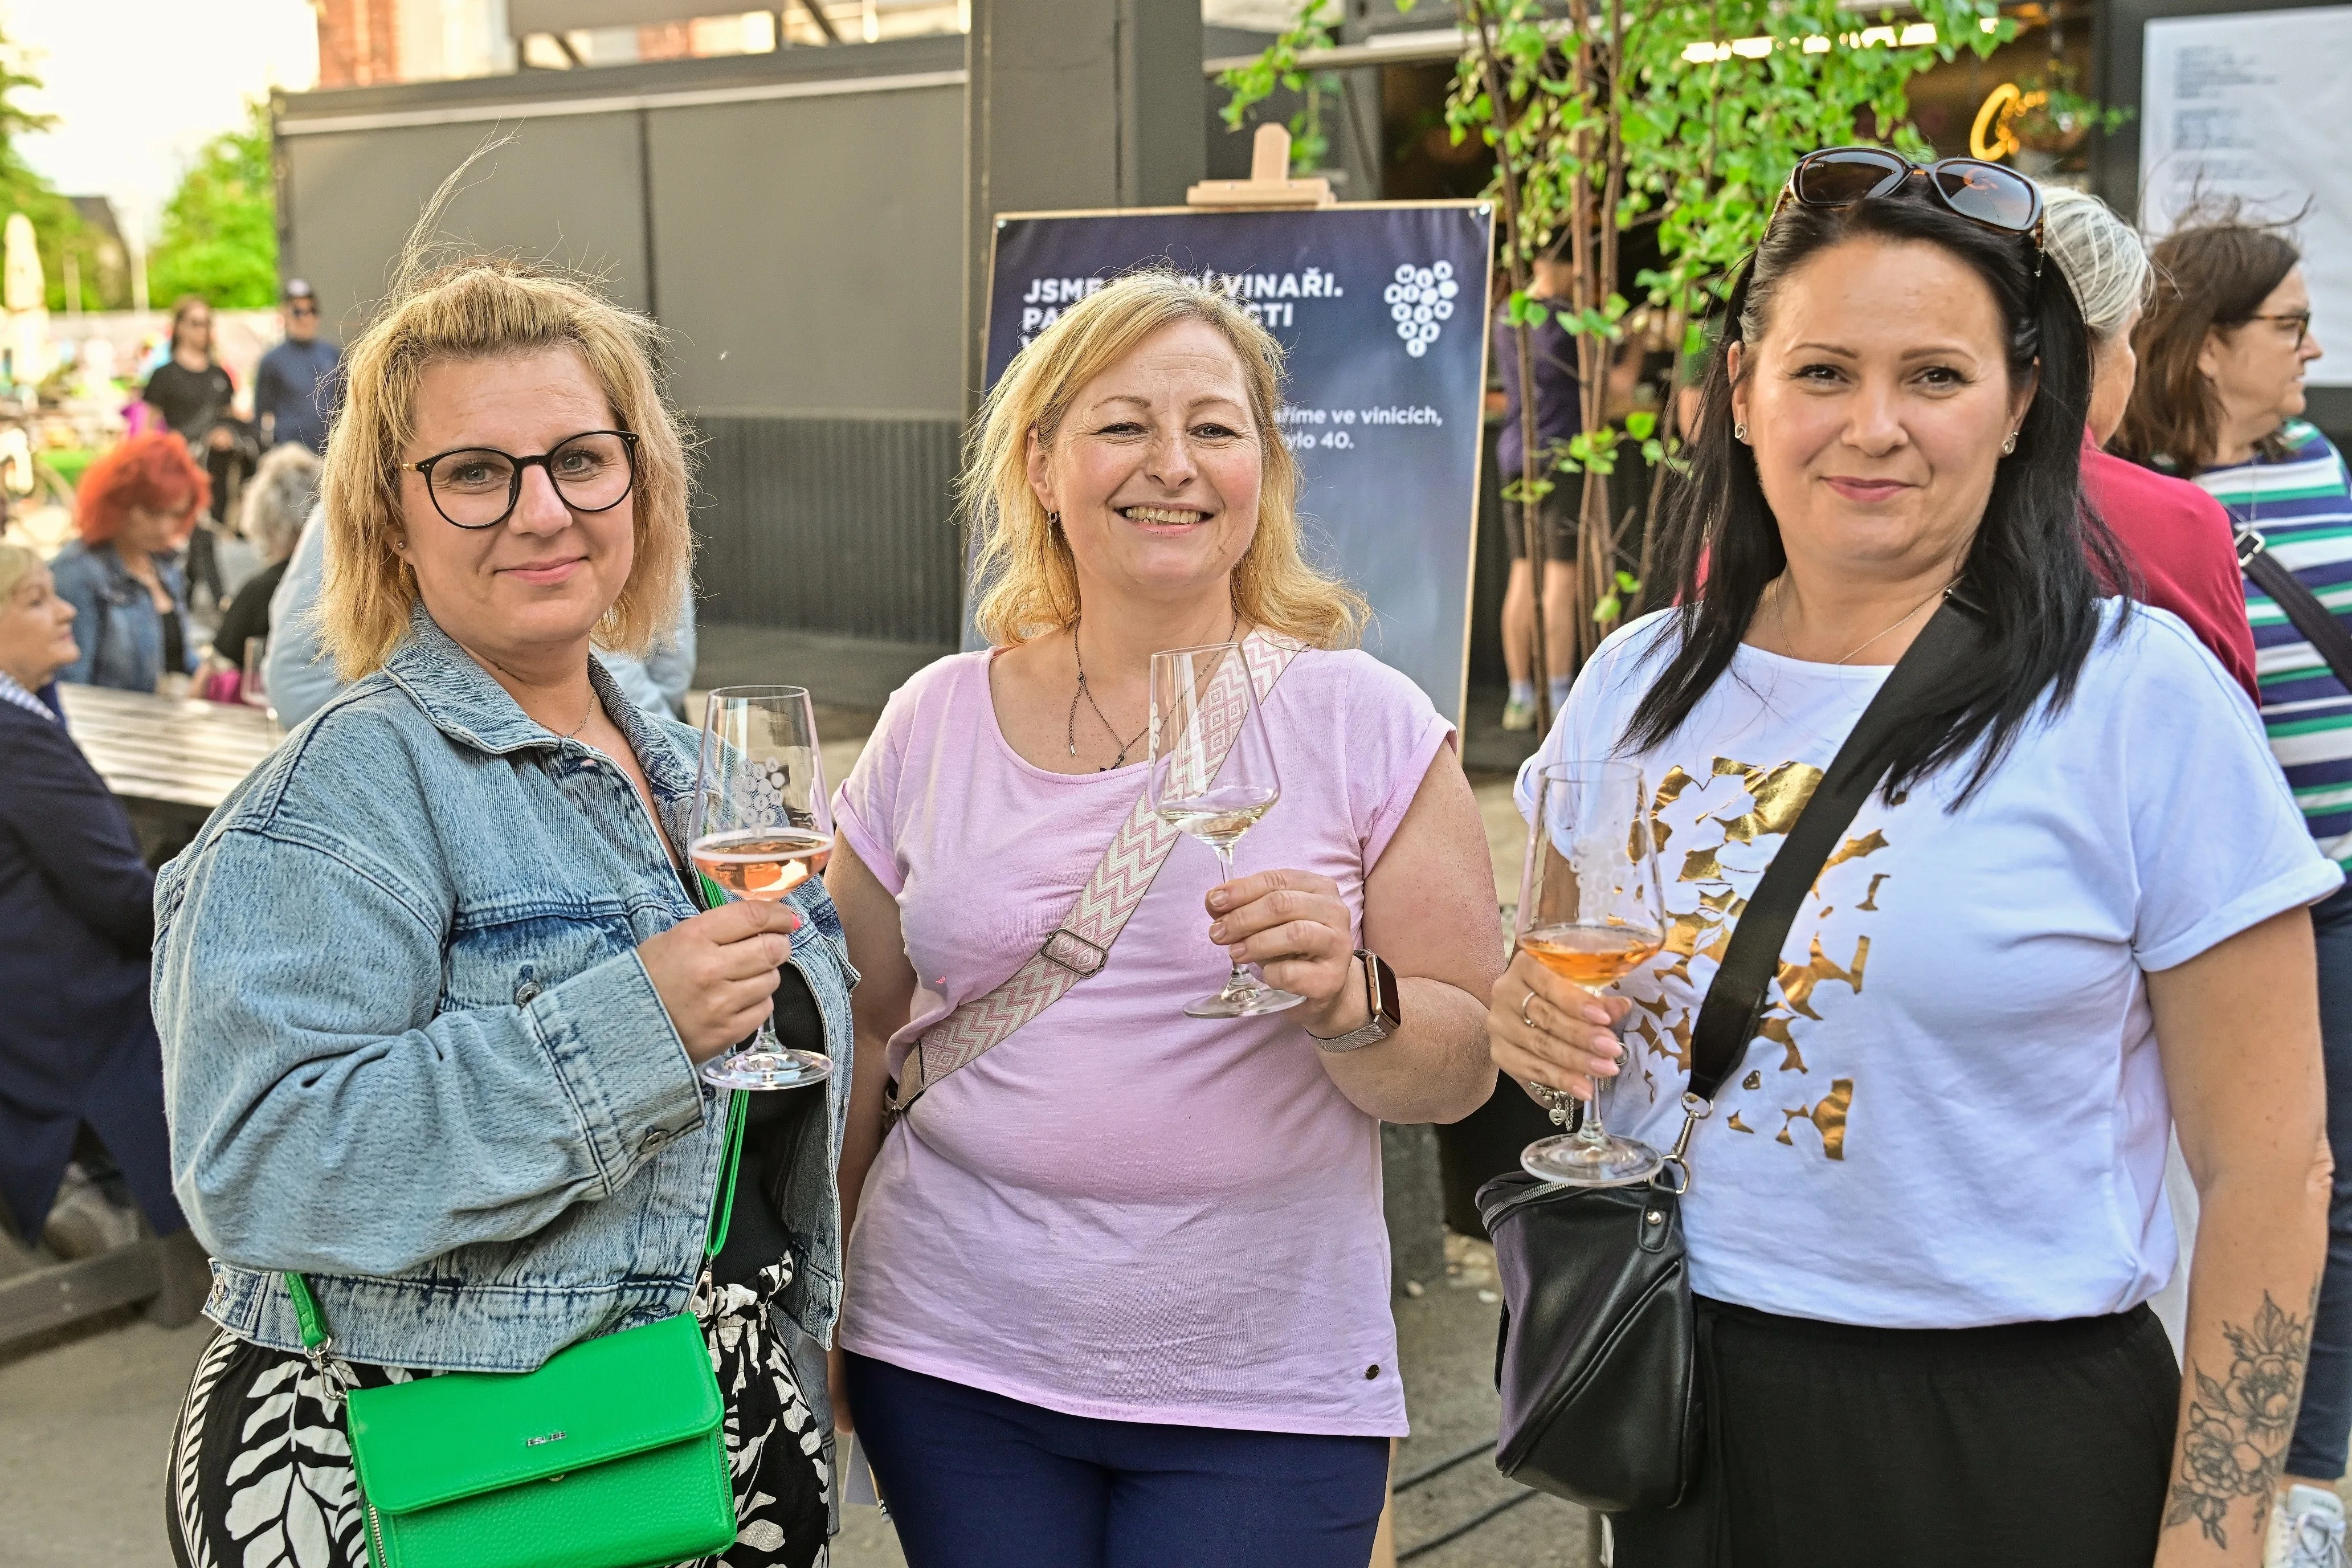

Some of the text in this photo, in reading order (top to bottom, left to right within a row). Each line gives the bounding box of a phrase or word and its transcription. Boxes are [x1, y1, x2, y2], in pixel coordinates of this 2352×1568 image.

[1331, 409, 1357, 425] ve
[1360, 405, 1443, 427] vinicích,
[1320, 430, 1355, 450] 40.
